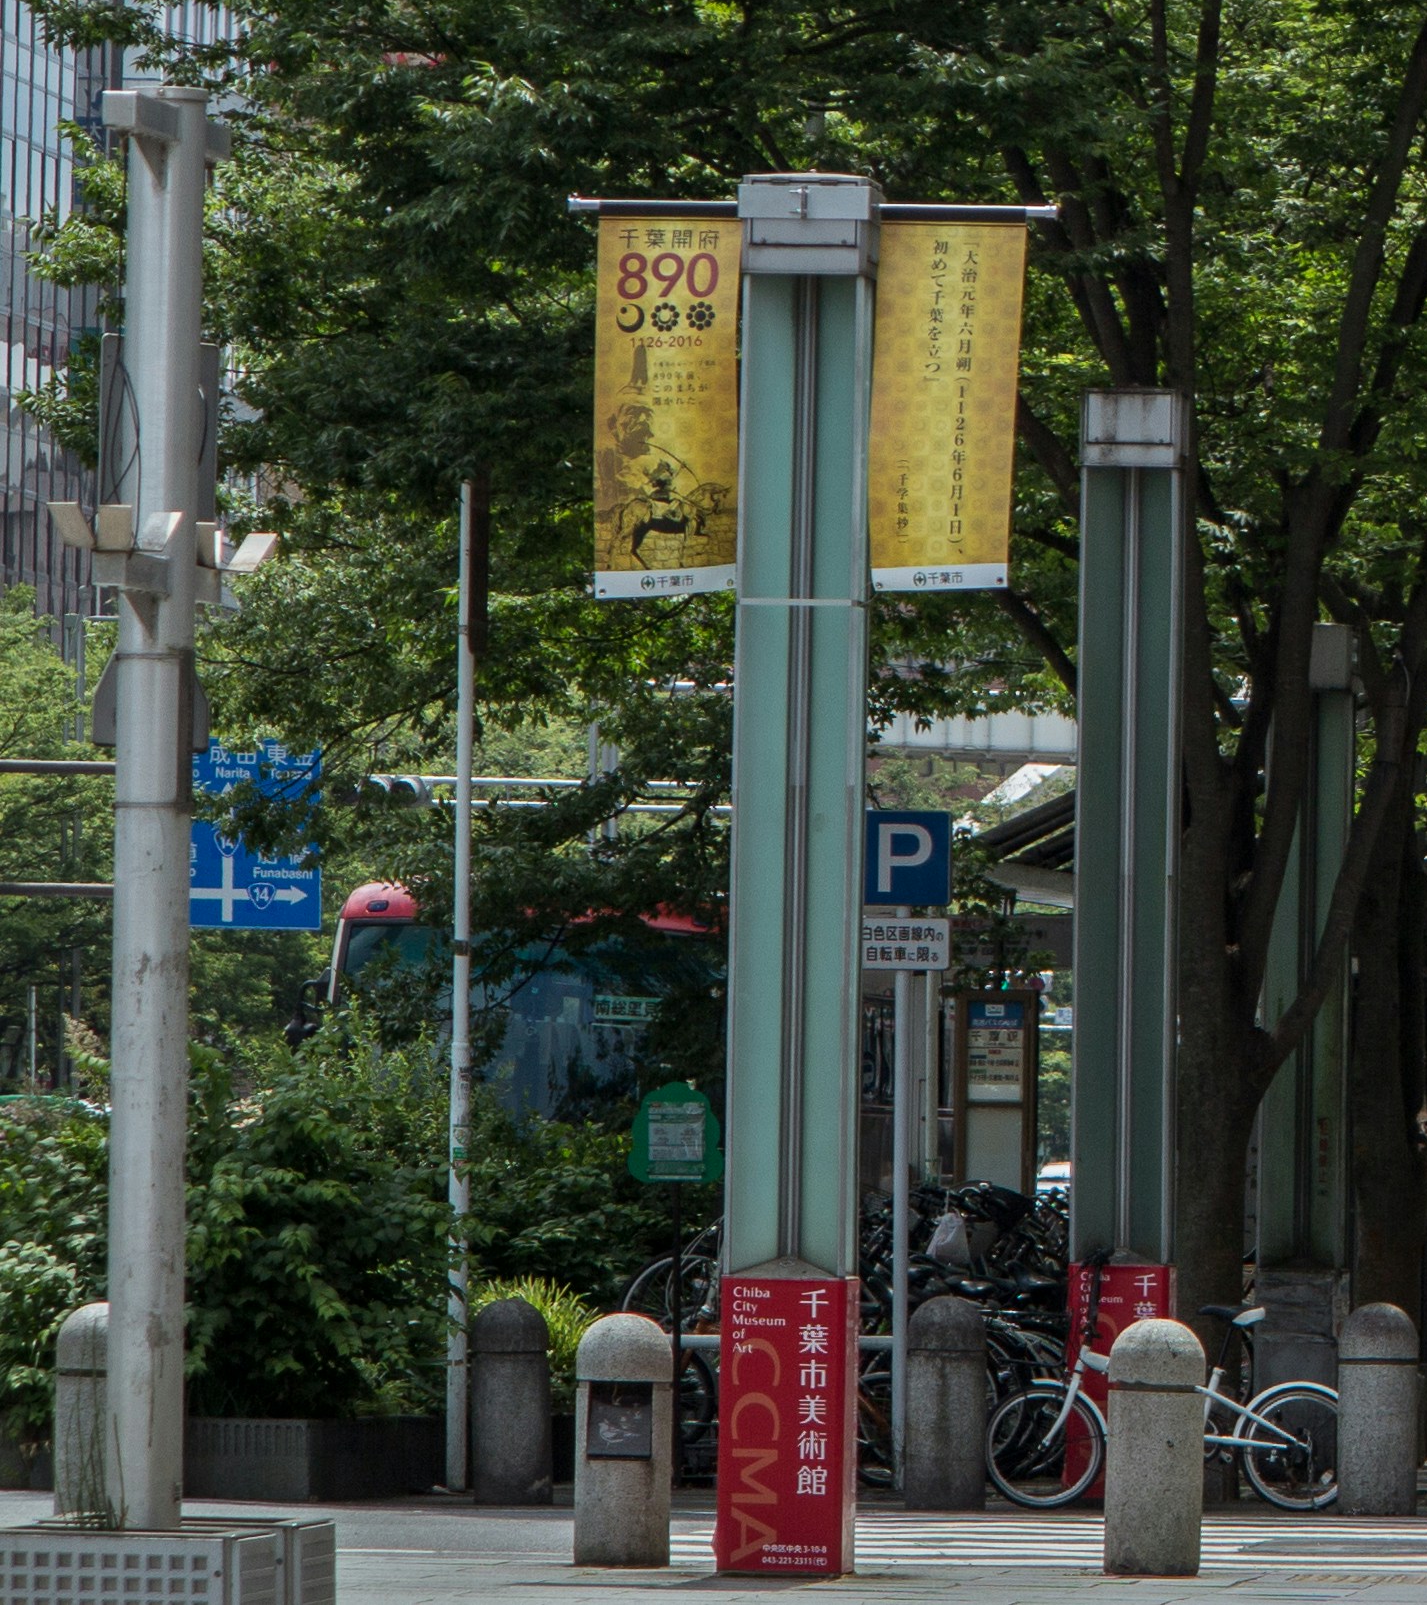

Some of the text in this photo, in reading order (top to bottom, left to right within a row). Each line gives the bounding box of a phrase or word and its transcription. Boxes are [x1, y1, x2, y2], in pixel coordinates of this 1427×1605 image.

[618, 228, 721, 250] 千葉開府
[617, 252, 720, 300] 890
[630, 335, 703, 349] 1126-2016
[656, 575, 694, 588] 千葉市
[927, 571, 964, 586] 千葉市
[215, 767, 250, 779] Narita
[877, 823, 932, 893] P
[254, 886, 269, 902] 14
[866, 946, 939, 962] 自転車に限る
[732, 1286, 771, 1299] Chiba
[732, 1300, 758, 1314] City
[732, 1313, 786, 1327] Museum
[732, 1328, 746, 1340] of
[732, 1341, 753, 1354] Art
[797, 1288, 829, 1496] 千葉市美術館
[730, 1337, 781, 1564] CCMA
